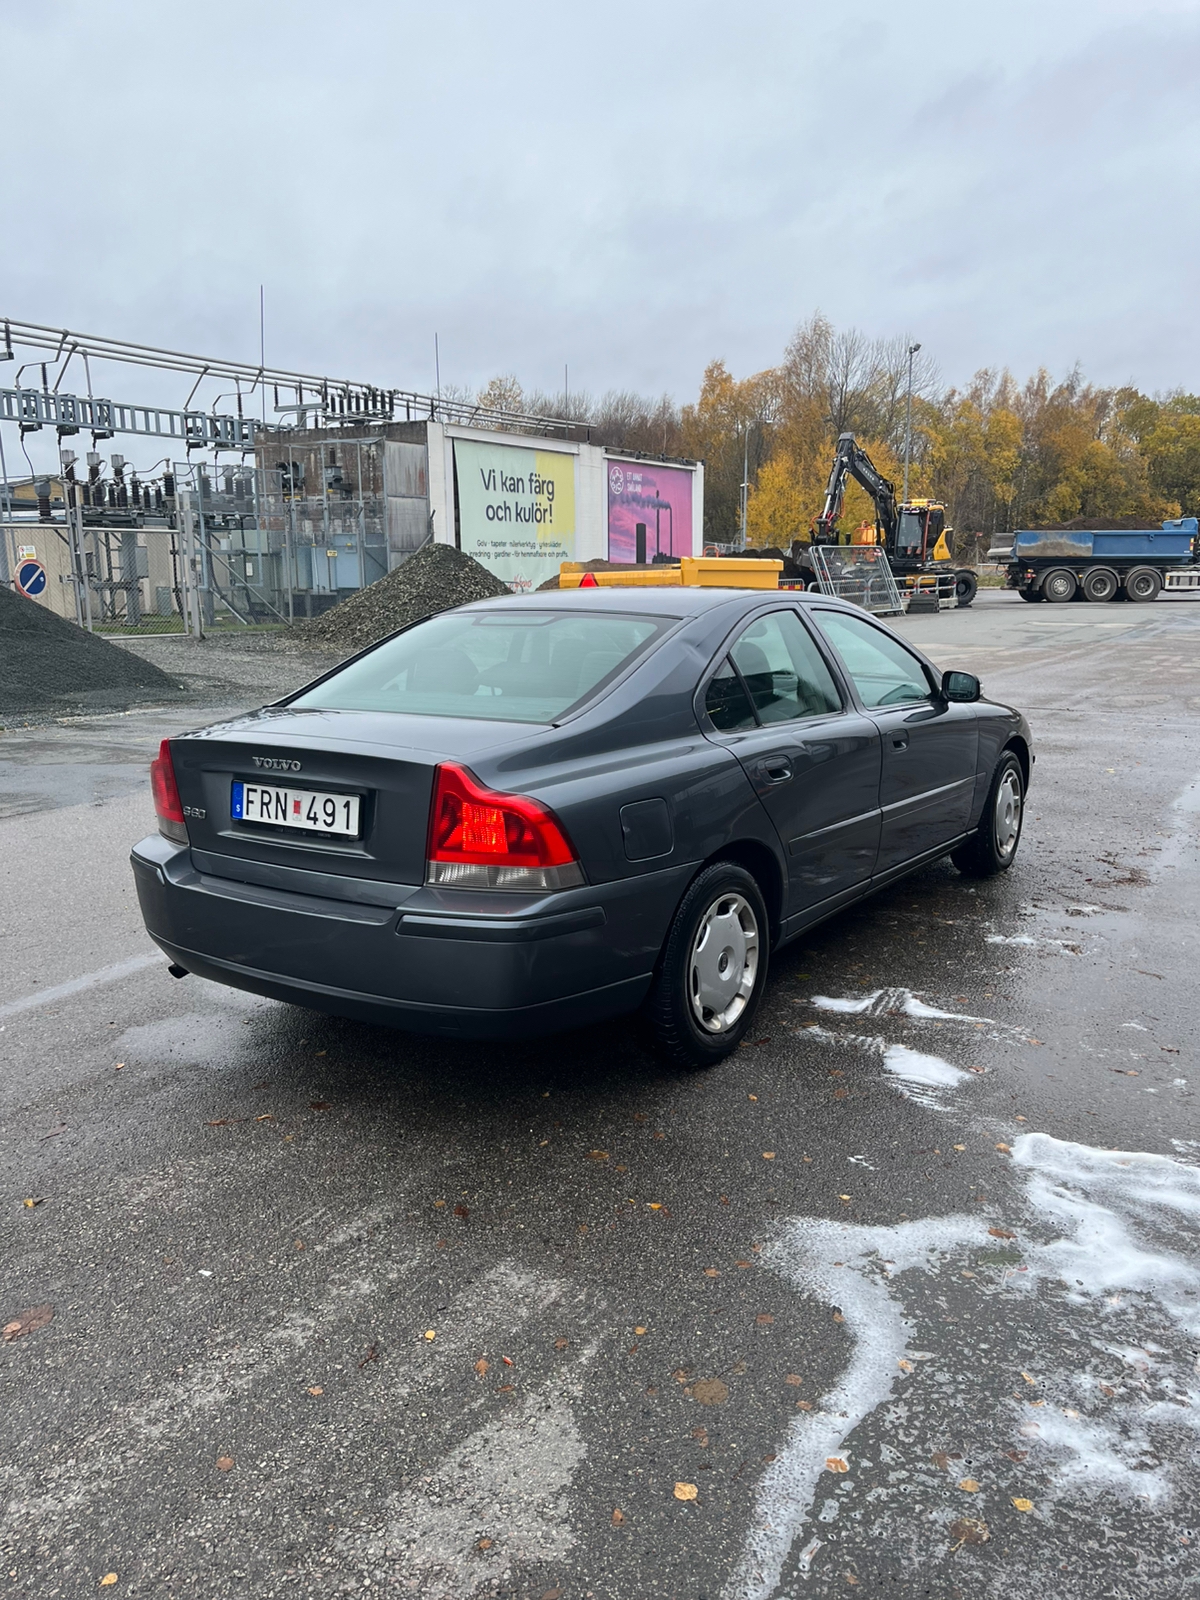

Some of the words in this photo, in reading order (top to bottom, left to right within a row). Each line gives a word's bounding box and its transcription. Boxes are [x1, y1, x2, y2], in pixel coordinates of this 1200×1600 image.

[480, 468, 496, 491] Vi
[500, 470, 525, 493] kan
[528, 472, 555, 502] färg
[485, 500, 511, 522] och
[515, 501, 553, 523] kulör!
[252, 756, 302, 772] VOLVO
[182, 805, 207, 819] S60
[235, 804, 241, 813] S
[246, 787, 288, 822] FRN
[306, 795, 351, 831] 491
